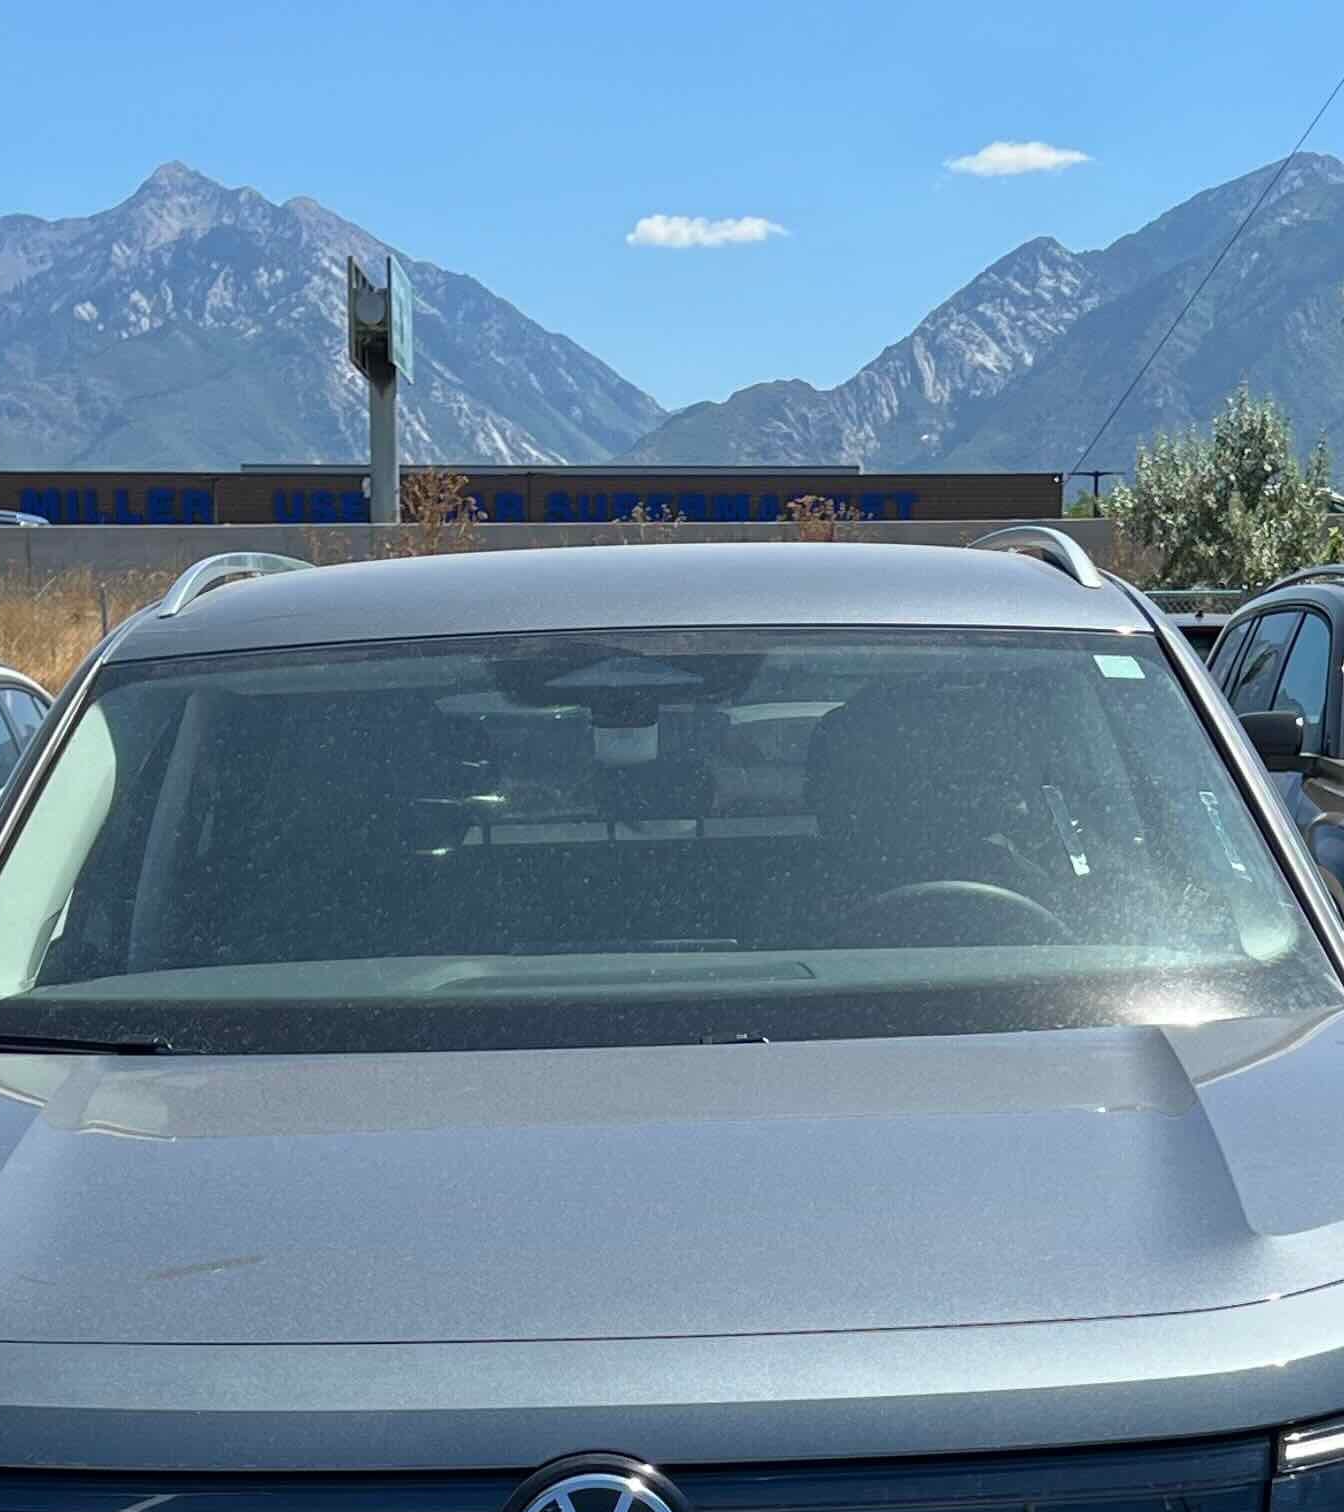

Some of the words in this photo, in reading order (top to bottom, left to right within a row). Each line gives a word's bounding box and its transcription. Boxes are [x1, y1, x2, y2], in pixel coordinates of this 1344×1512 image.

[20, 487, 213, 524] MILLER
[273, 489, 371, 523] USE
[544, 490, 919, 522] SUPERMAET
